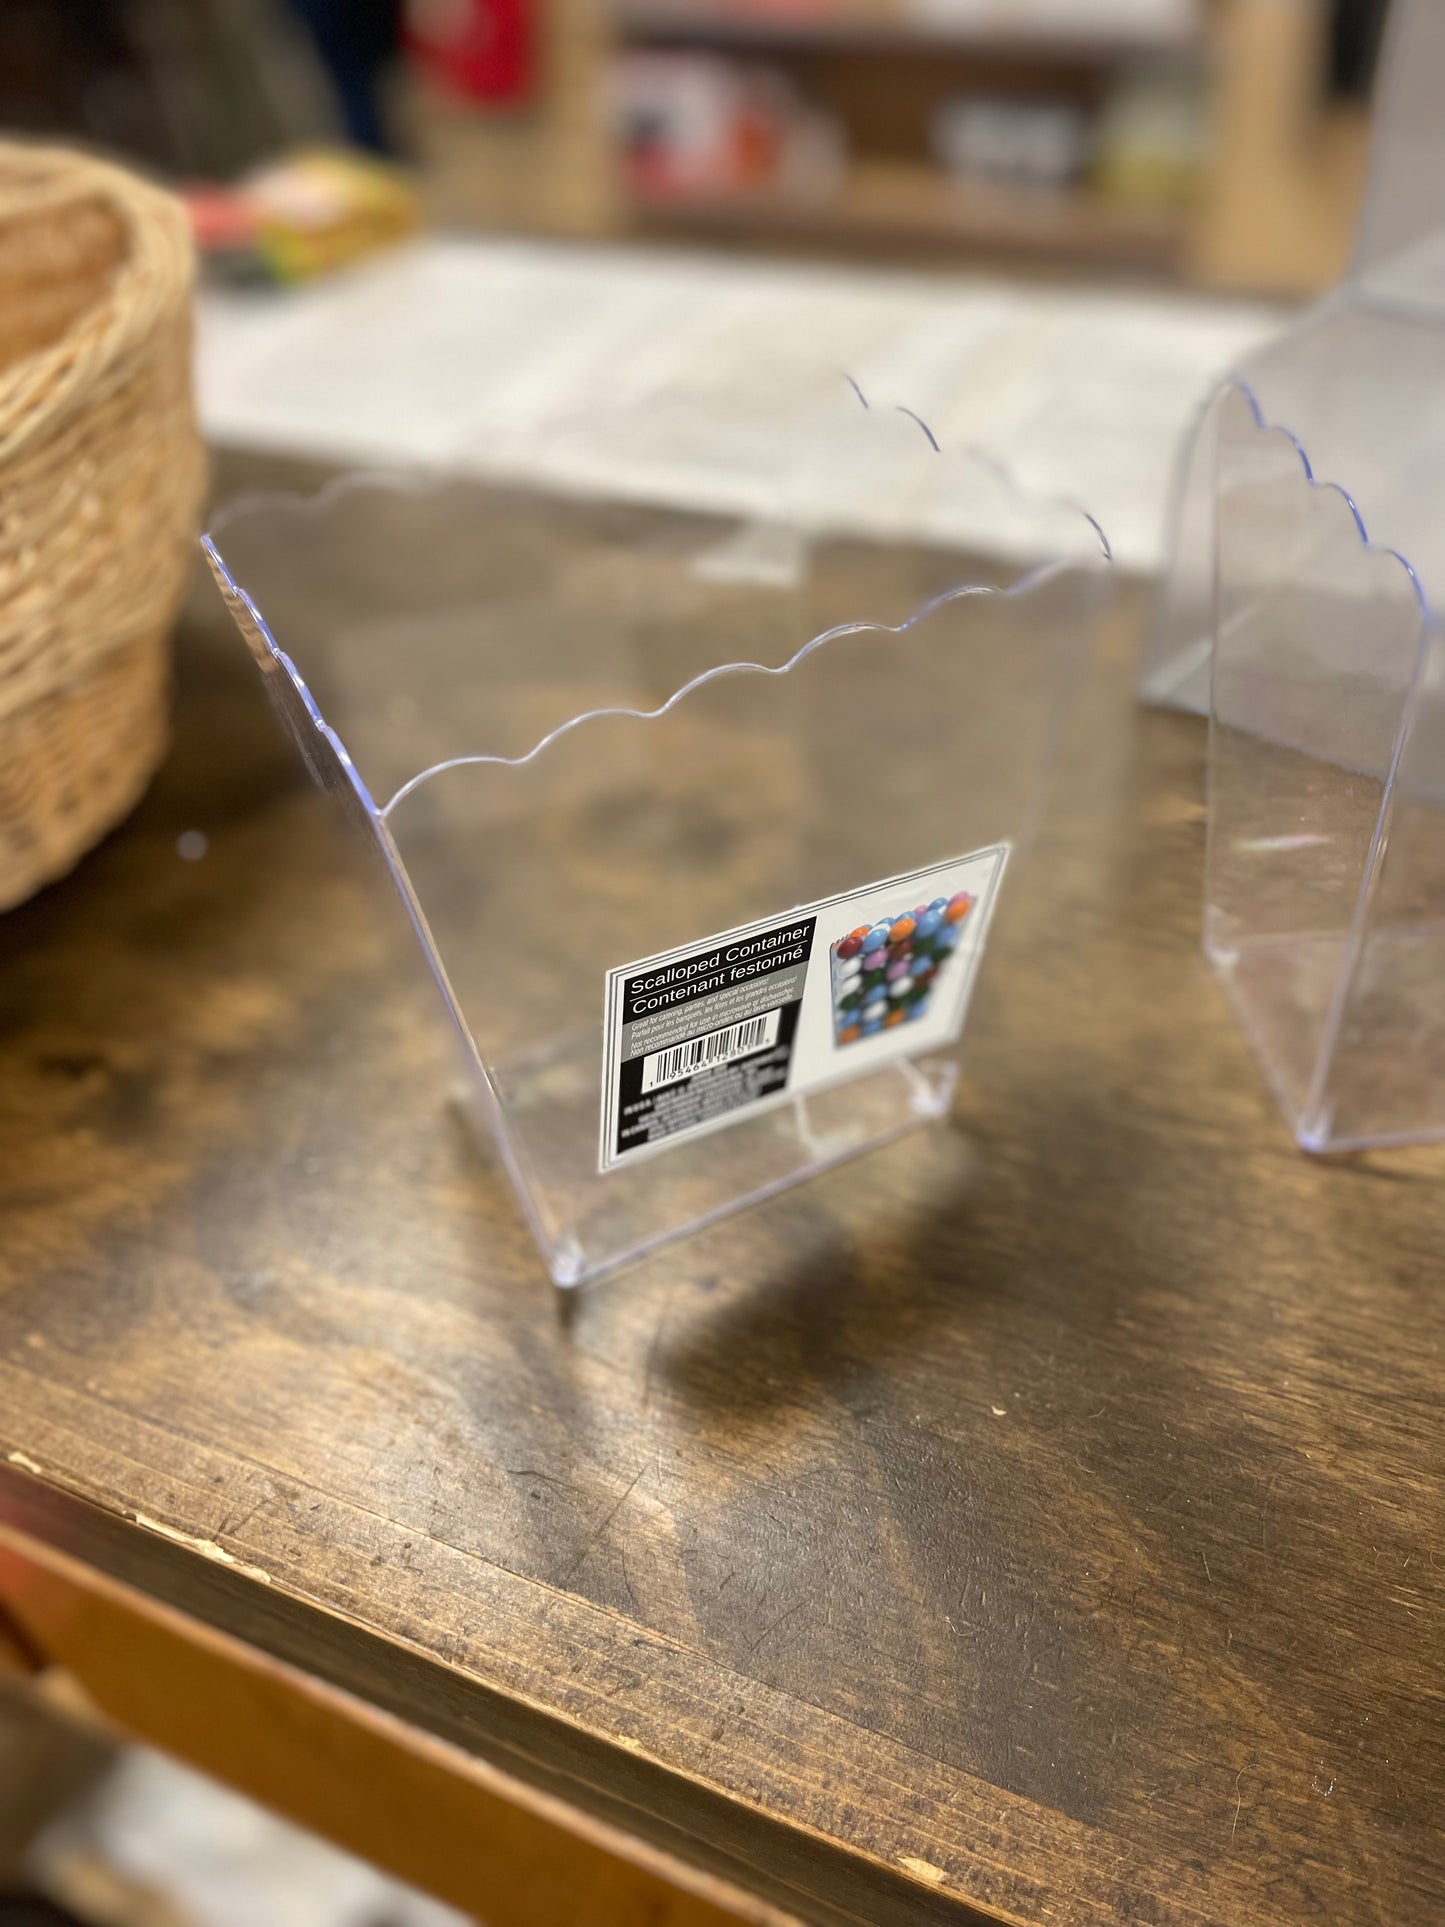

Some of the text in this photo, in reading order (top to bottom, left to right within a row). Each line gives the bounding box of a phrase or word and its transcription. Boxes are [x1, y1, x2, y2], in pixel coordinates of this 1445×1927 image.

[631, 925, 810, 996] Scalloped Container
[632, 945, 804, 1014] Contenant festonné
[630, 1038, 643, 1050] Not
[643, 1022, 689, 1046] recommended
[688, 1019, 699, 1029] for
[698, 1015, 711, 1026] use
[711, 1012, 718, 1021] in
[718, 1001, 752, 1019] microwave
[751, 998, 759, 1007] or
[631, 1018, 649, 1031] Great
[648, 1014, 659, 1025] for
[657, 1006, 683, 1023] catering,
[706, 993, 718, 1005] and
[718, 986, 739, 1002] special
[738, 976, 769, 993] occasions!
[631, 1026, 650, 1040] Parfait
[650, 1022, 665, 1034] pour
[665, 1017, 675, 1028] les
[703, 1004, 713, 1014] les
[713, 998, 728, 1010] fêtes
[728, 996, 735, 1005] et
[734, 993, 744, 1003] les
[743, 985, 768, 1001] grandes
[630, 1045, 644, 1057] Non
[644, 1030, 686, 1052] recommandé
[686, 1027, 695, 1037] au
[695, 1013, 734, 1034] micro-ondes
[733, 1010, 743, 1020] ou
[743, 1007, 752, 1016] au
[649, 1080, 654, 1088] 1
[669, 1060, 708, 1080] 95464
[716, 1043, 752, 1062] 12801
